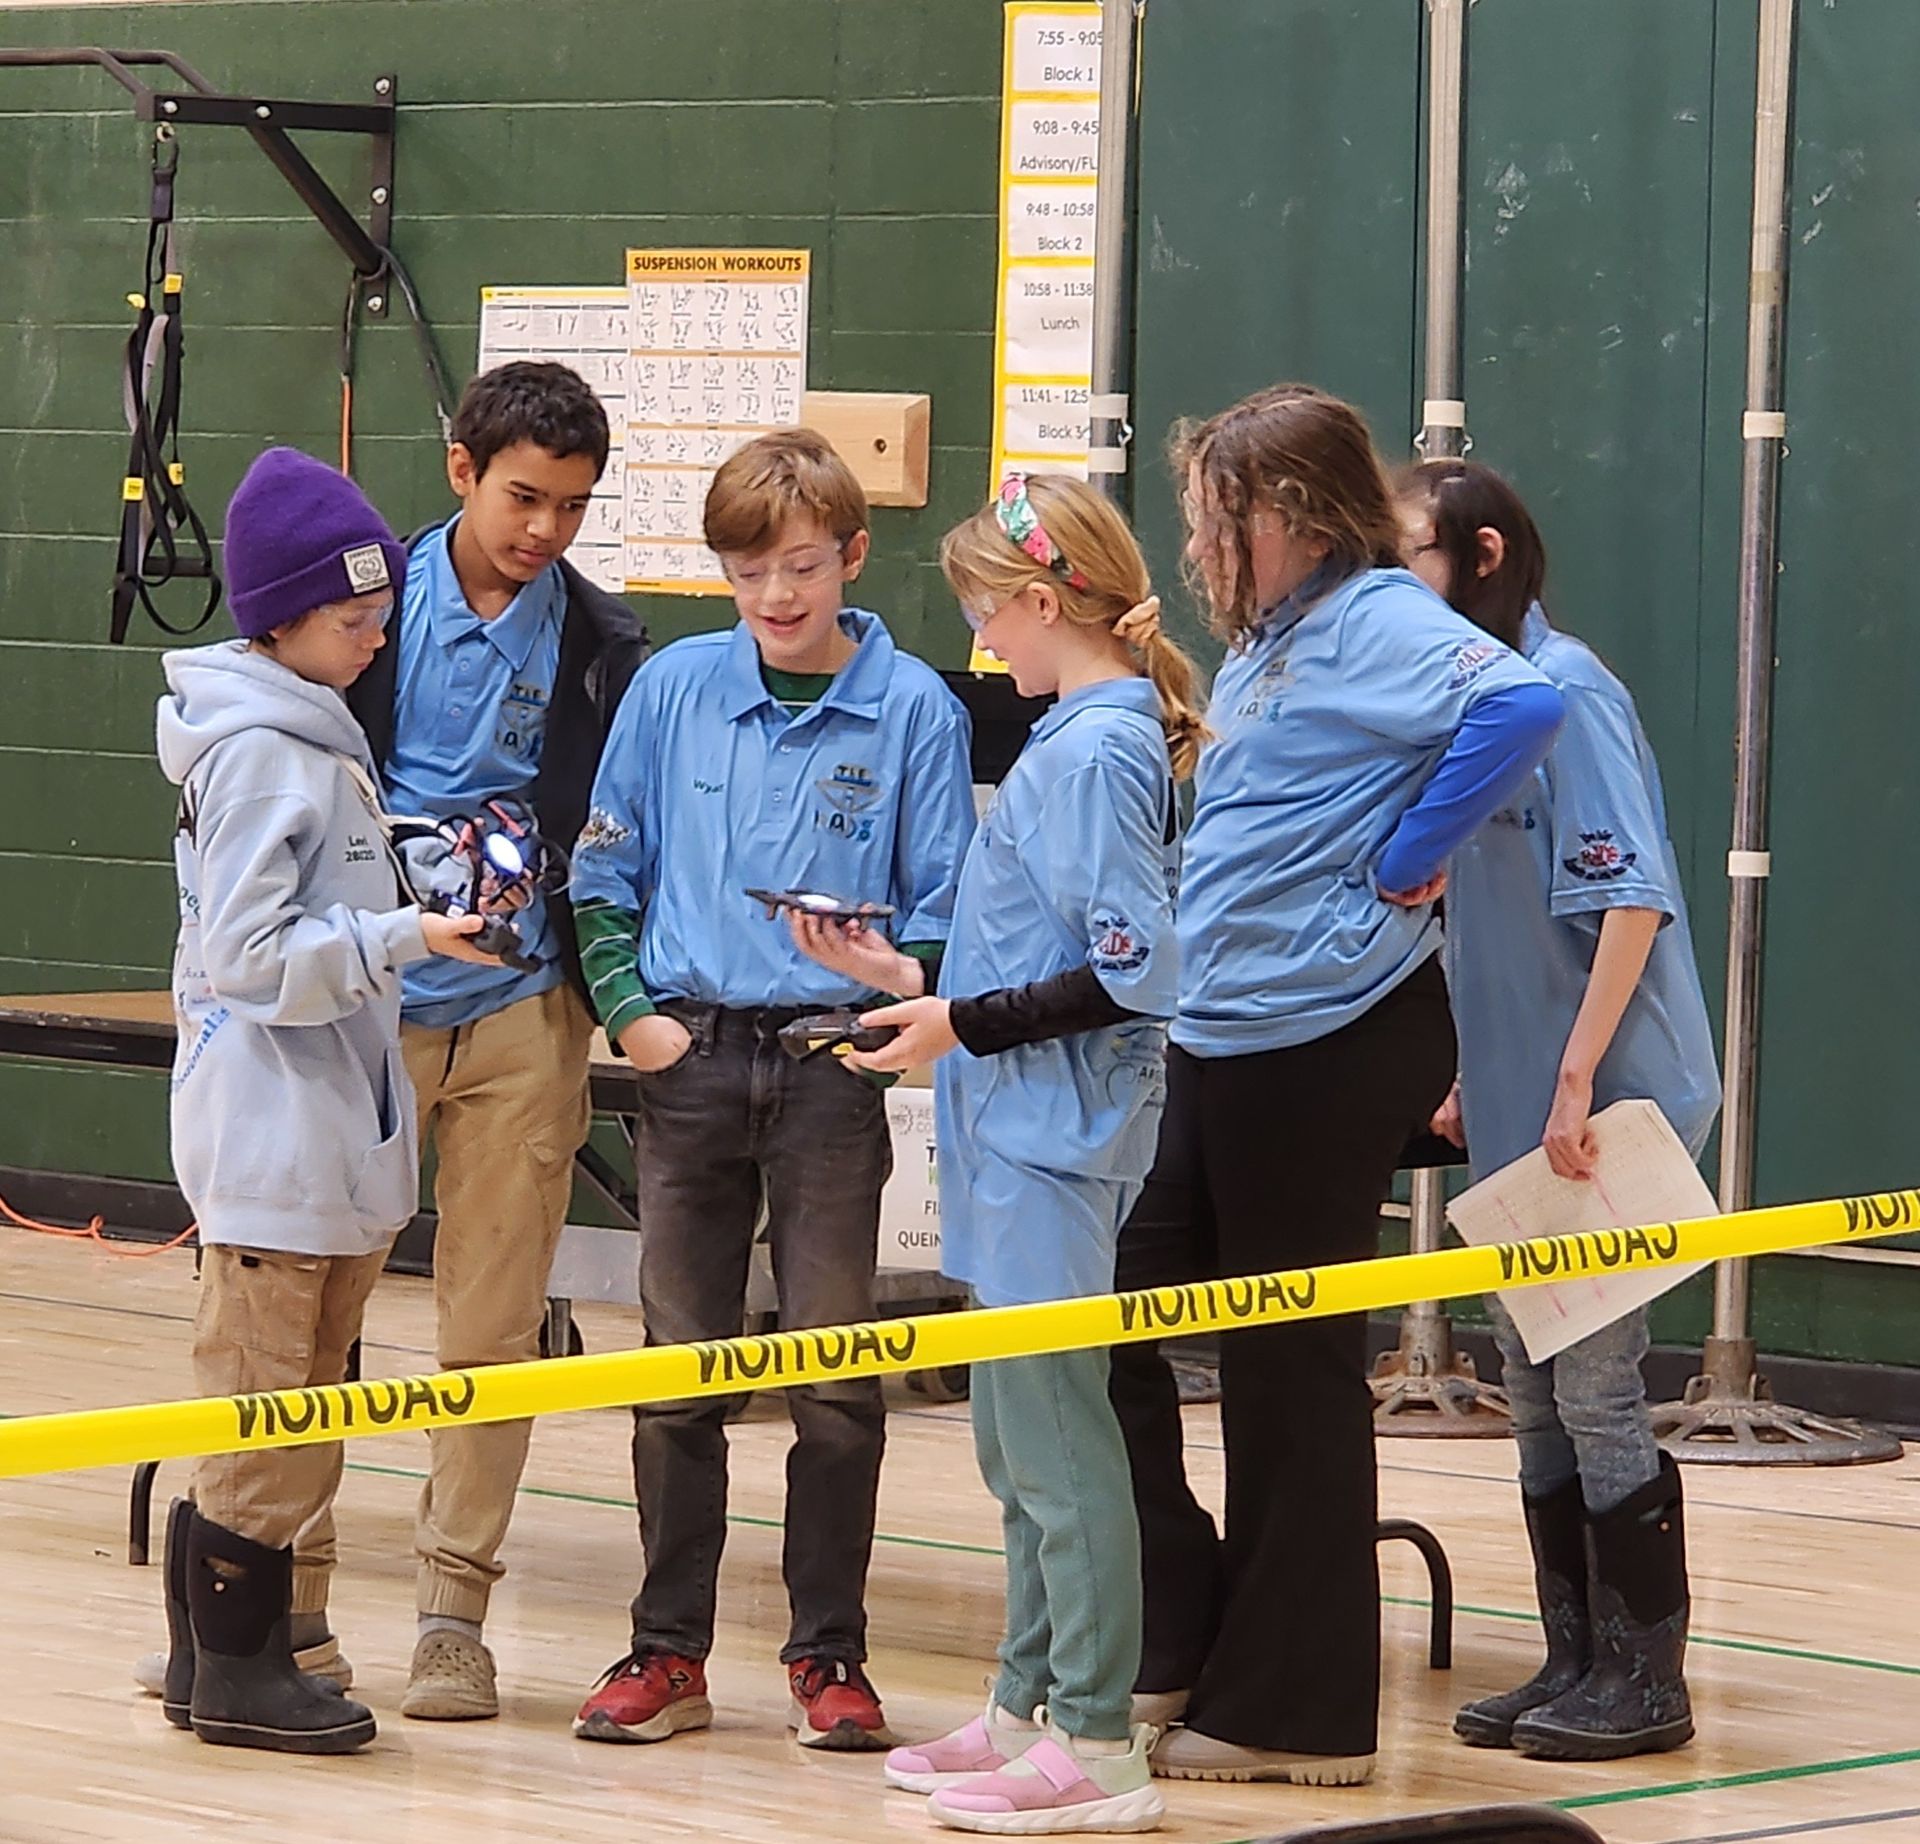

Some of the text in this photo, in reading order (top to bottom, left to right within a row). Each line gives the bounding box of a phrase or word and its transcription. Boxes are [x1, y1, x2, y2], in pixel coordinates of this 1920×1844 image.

[1037, 31, 1064, 45] 7:55
[1044, 67, 1094, 81] Block 1
[1033, 120, 1058, 135] 9:08
[1071, 120, 1099, 135] 9:45
[1020, 156, 1097, 173] Advisory/FL
[1026, 203, 1050, 216] 9:48
[1063, 203, 1095, 216] 10:58
[1038, 237, 1082, 250] Block 2
[634, 257, 802, 271] SUSPENSION WORKOUTS
[1024, 283, 1051, 297] 10:58
[1064, 283, 1094, 297] 11:38
[1041, 317, 1080, 330] Lunch
[1022, 389, 1051, 403] 11:41
[1038, 425, 1071, 439] Block
[924, 1200, 941, 1215] FI
